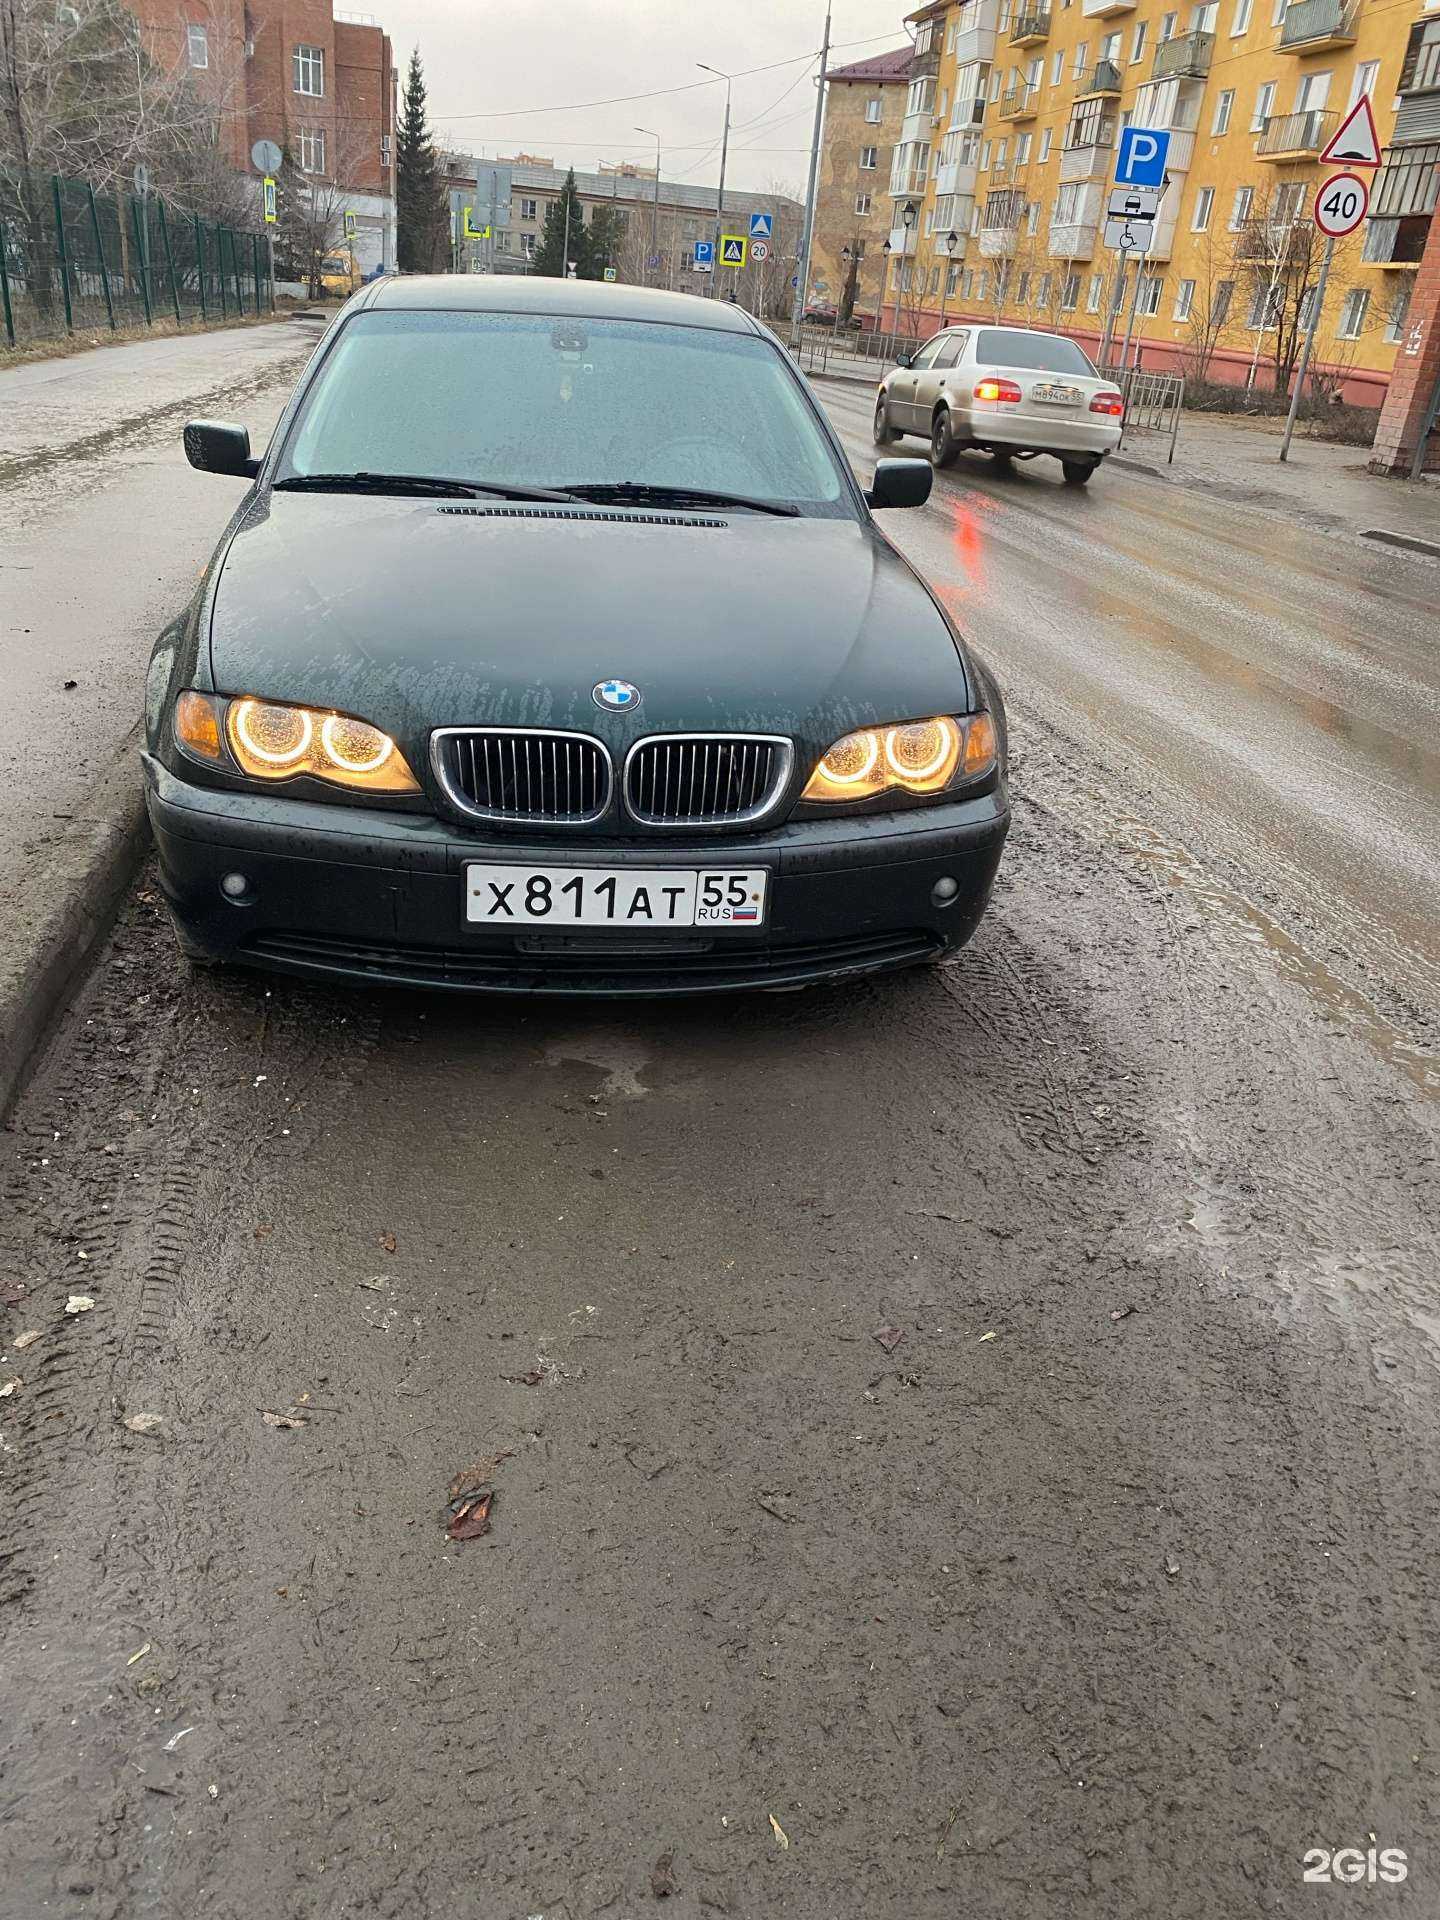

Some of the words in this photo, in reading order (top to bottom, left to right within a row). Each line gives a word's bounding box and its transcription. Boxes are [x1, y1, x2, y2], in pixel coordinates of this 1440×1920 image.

[1125, 133, 1158, 179] P
[1323, 191, 1357, 219] 40
[697, 243, 709, 260] P
[753, 246, 766, 257] 20
[487, 875, 686, 919] Х811АТ
[702, 876, 748, 907] 55
[698, 908, 732, 920] RUS
